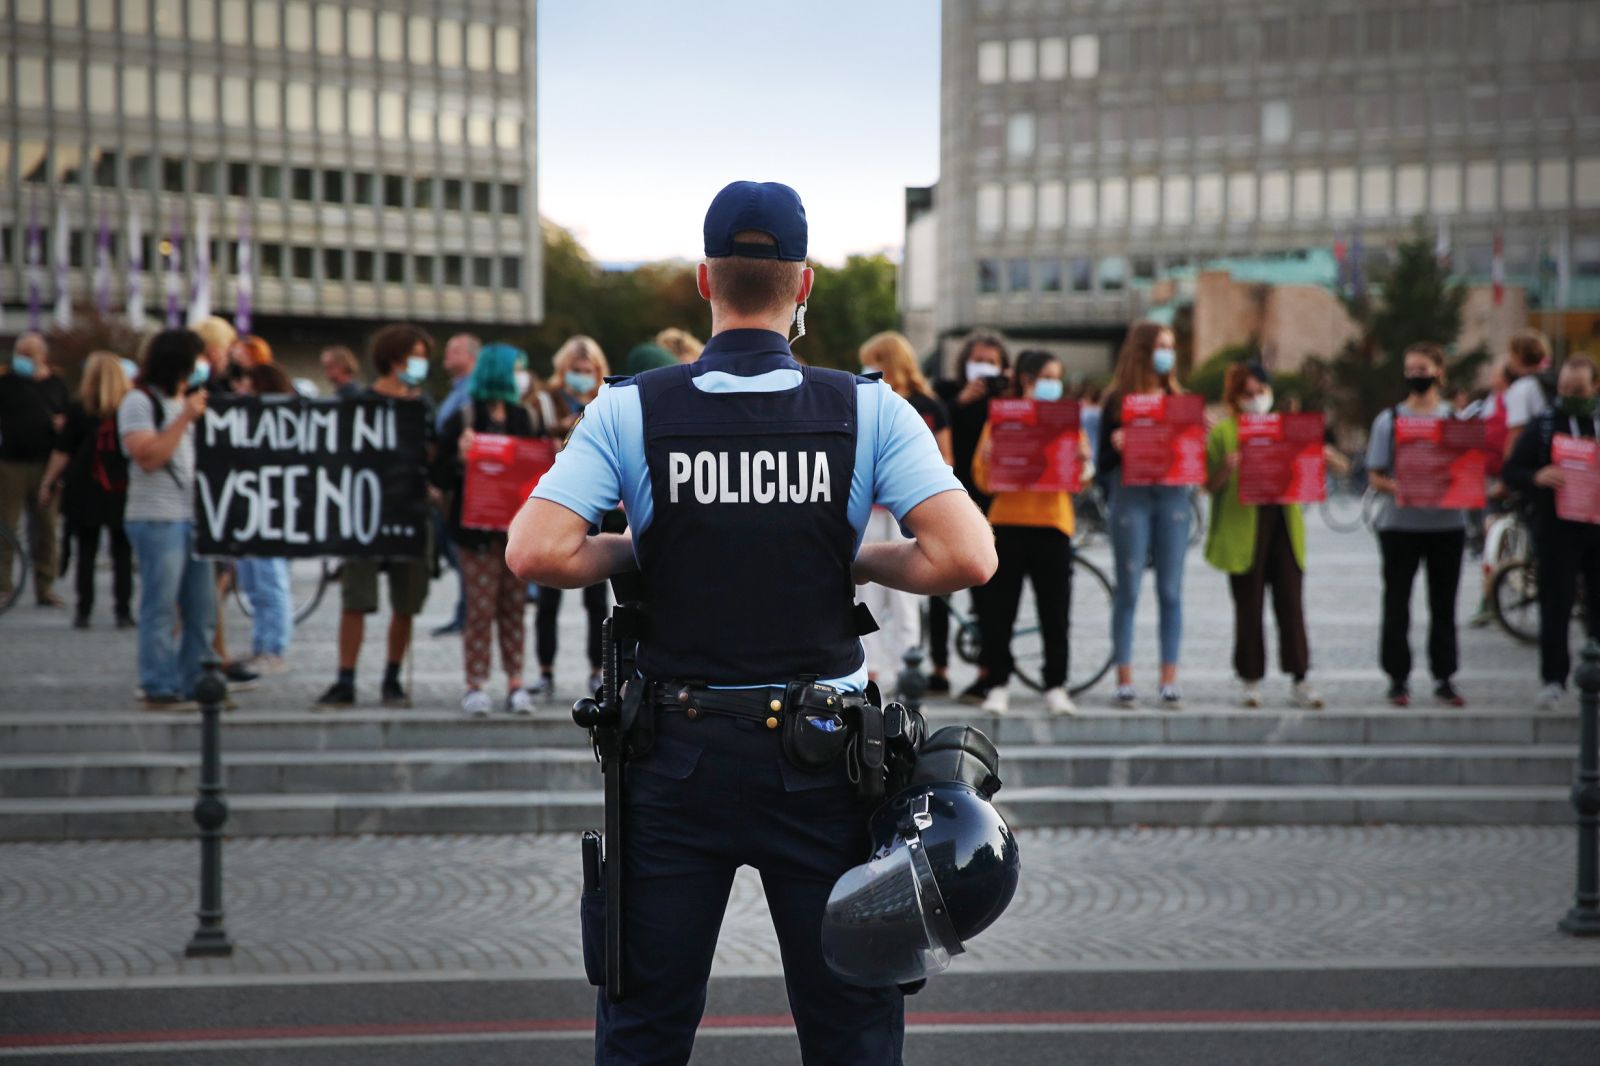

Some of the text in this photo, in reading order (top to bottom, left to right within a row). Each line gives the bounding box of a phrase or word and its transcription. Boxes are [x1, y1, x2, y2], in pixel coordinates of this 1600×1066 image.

[205, 406, 397, 453] MLADIM NI
[669, 451, 831, 504] POLICIJA
